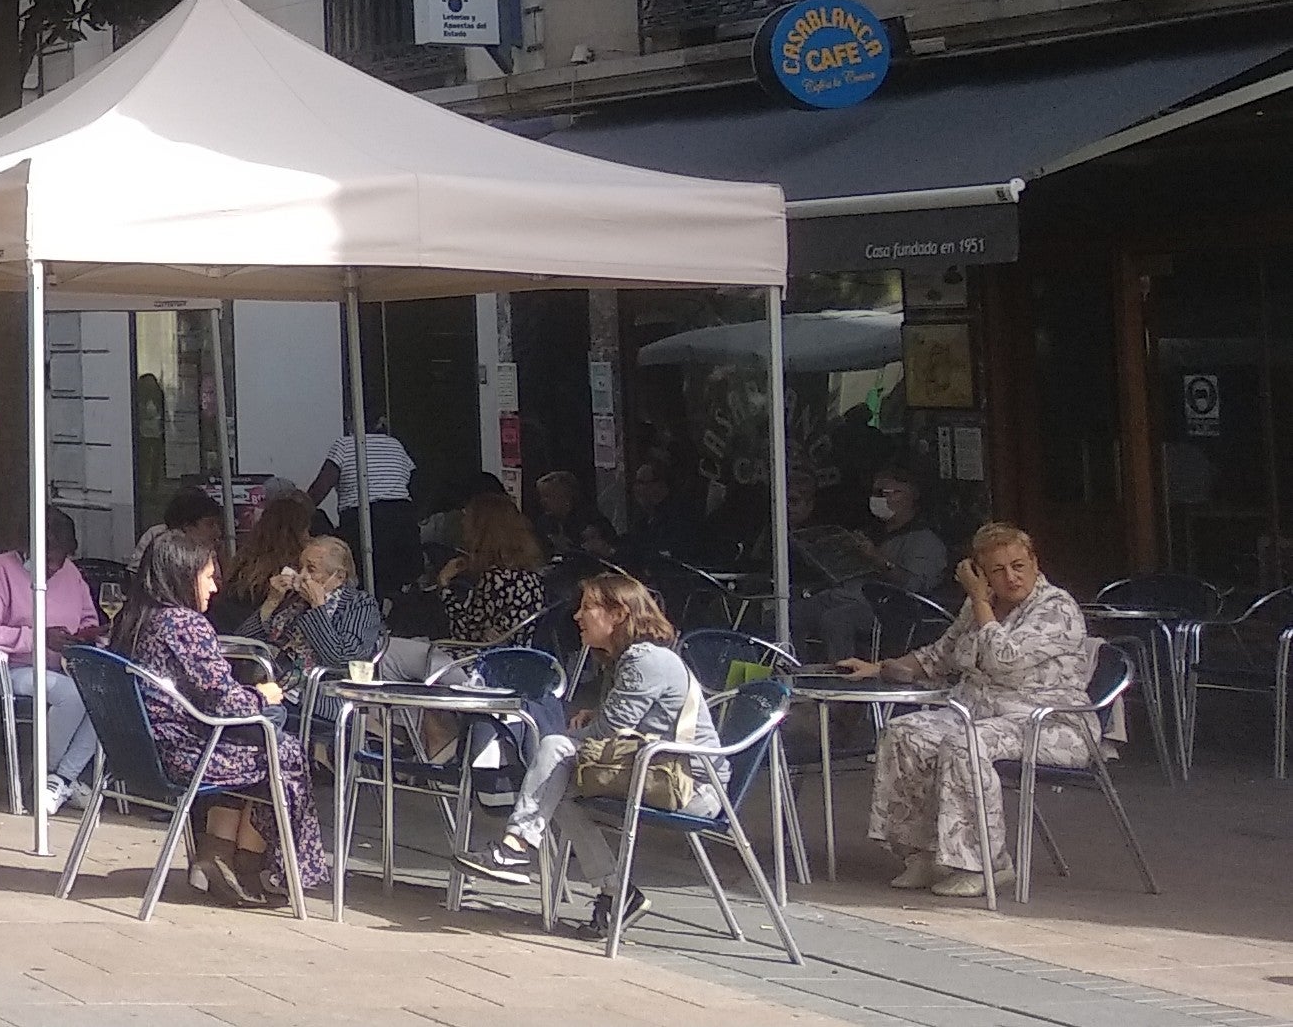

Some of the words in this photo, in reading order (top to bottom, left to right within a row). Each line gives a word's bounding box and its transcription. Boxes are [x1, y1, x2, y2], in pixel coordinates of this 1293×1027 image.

[783, 7, 883, 75] CASABLANCA
[865, 244, 890, 259] Casa
[940, 241, 955, 255] en
[959, 237, 985, 254] 1951
